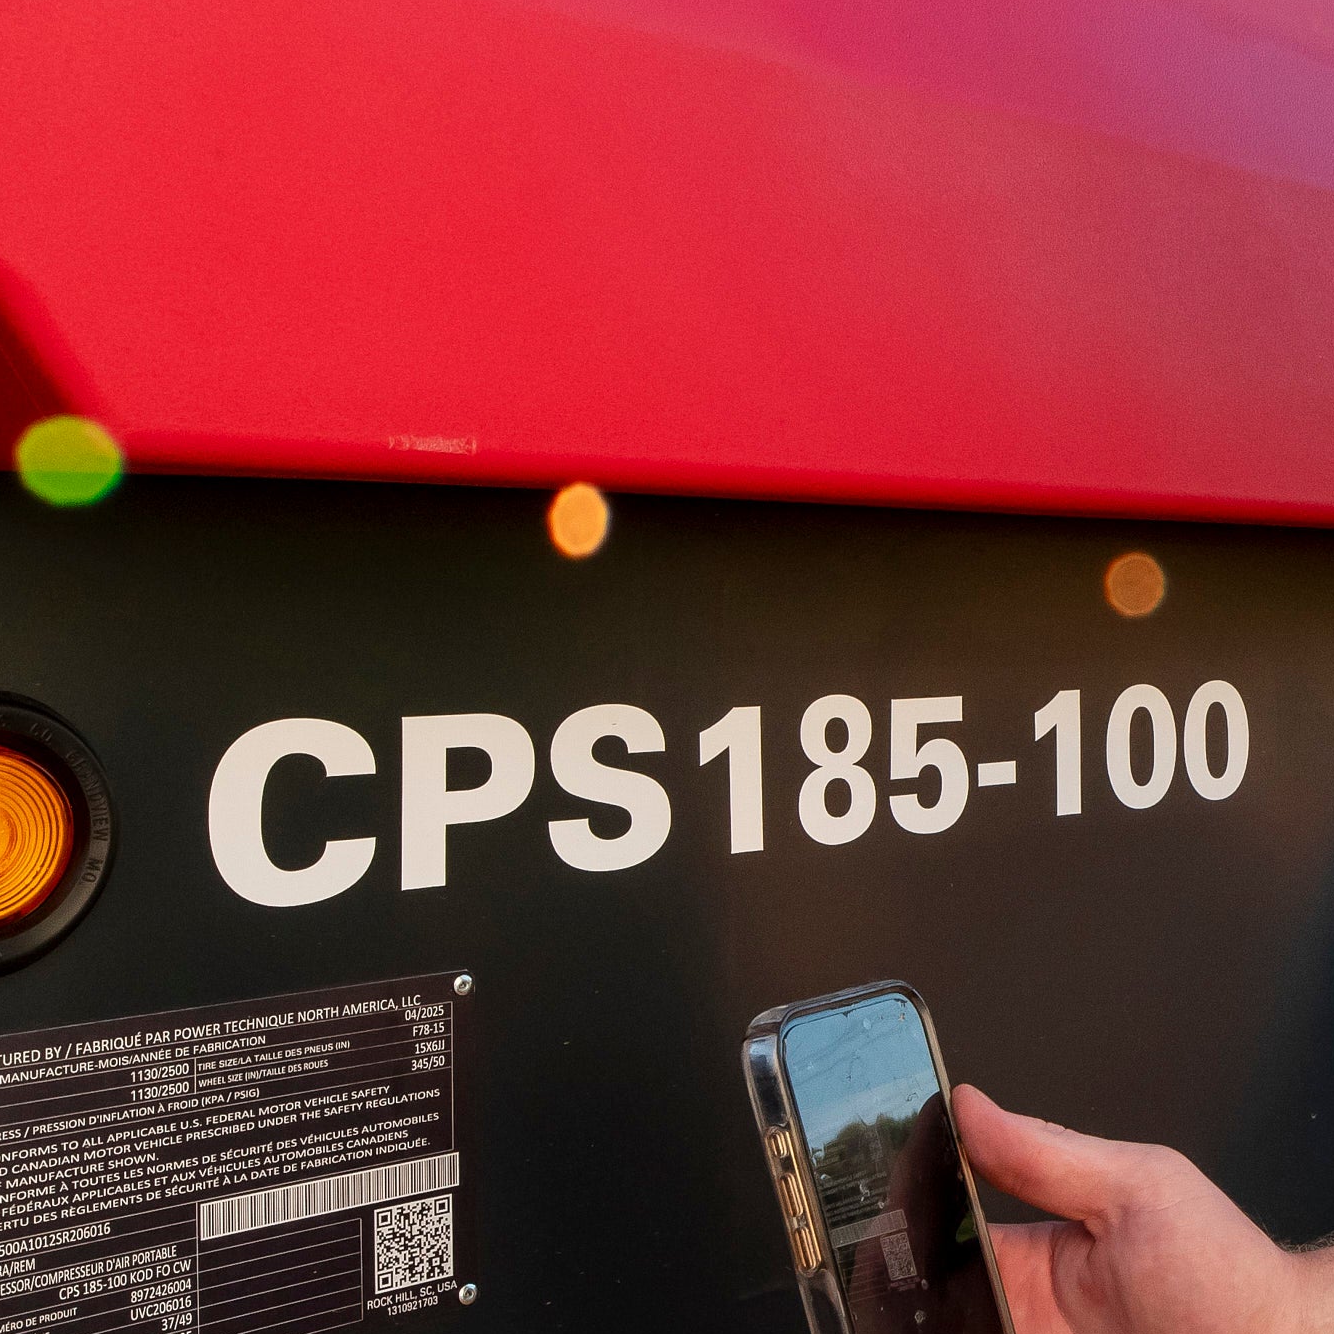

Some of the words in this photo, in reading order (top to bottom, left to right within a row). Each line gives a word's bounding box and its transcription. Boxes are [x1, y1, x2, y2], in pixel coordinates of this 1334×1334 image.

[44, 1045, 62, 1061] BY
[75, 1031, 142, 1056] FABRIQUÉ
[145, 1030, 171, 1046] PAR
[173, 1022, 221, 1042] POWER
[223, 1014, 295, 1034] TECHNIQUE
[297, 1005, 339, 1023] NORTH
[341, 998, 399, 1017] AMERICA,
[401, 994, 422, 1008] LLC
[404, 1004, 445, 1021] 04/2025
[412, 1021, 445, 1037] F78-15
[0, 1047, 172, 1085] MANUFACTURE-MOIS/ANNÉE
[175, 1046, 191, 1058] DE
[193, 1034, 266, 1055] FABRICATION
[196, 1060, 217, 1072] TIRE
[218, 1055, 252, 1069] SIZE/LA
[253, 1050, 283, 1063] TAILLE
[284, 1047, 303, 1058] DES
[304, 1042, 334, 1055] PNEUS
[411, 1054, 446, 1071] 345/50
[130, 1062, 190, 1083] 1130/2500
[130, 1081, 190, 1102] 1130/2500
[11, 1153, 80, 1175] CANADIAN
[83, 1143, 132, 1161] MOTOR
[133, 1134, 183, 1152] VEHICLE
[185, 1121, 255, 1142] PRESCRIBED
[257, 1113, 297, 1129] UNDER
[299, 1109, 321, 1121] THE
[323, 1101, 364, 1117] SAFETY
[365, 1088, 441, 1110] REGULATIONS
[32, 1117, 86, 1136] PRESSION
[88, 1105, 155, 1126] D'INFLATION
[157, 1102, 166, 1114] À
[167, 1098, 199, 1112] FROID
[60, 1140, 79, 1152] TO
[81, 1136, 104, 1149] ALL
[106, 1122, 177, 1144] APPLICABLE
[180, 1118, 203, 1130] U.S.
[205, 1109, 256, 1126] FEDERAL
[258, 1100, 302, 1117] MOTOR
[303, 1092, 349, 1108] VEHICLE
[351, 1085, 390, 1100] SAFETY
[59, 1180, 69, 1193] À
[71, 1172, 121, 1190] TOUTES
[123, 1167, 144, 1180] LES
[146, 1157, 199, 1175] NORMES
[201, 1153, 218, 1165] DE
[220, 1141, 273, 1162] SÉCURITÉ
[276, 1138, 298, 1151] DES
[299, 1127, 359, 1146] VÉHICULES
[361, 1112, 440, 1135] AUTOMOBILES
[1, 1195, 69, 1218] FÉDÉRAUX
[71, 1179, 151, 1204] APPLICABLES
[154, 1175, 169, 1187] ET
[170, 1170, 196, 1184] AUX
[198, 1157, 261, 1178] VÉHICULES
[263, 1141, 345, 1166] AUTOMOBILES
[346, 1129, 409, 1149] CANADIENS
[5, 1161, 105, 1190] MANUFACTURE
[107, 1152, 159, 1170] SHOWN.
[33, 1211, 58, 1225] DES
[60, 1193, 143, 1219] RÈGLEMENTS
[146, 1189, 162, 1202] DE
[164, 1176, 220, 1198] SÉCURITÉ
[222, 1174, 232, 1186] À
[233, 1173, 249, 1184] LA
[250, 1166, 280, 1180] DATE
[282, 1162, 298, 1174] DE
[300, 1148, 373, 1170] FABRICATION
[375, 1137, 431, 1156] INDIQUÉE.
[106, 1255, 131, 1273] D'AIR
[131, 1244, 177, 1267] PORTABLE
[58, 1284, 80, 1301] CPS
[82, 1273, 128, 1295] 185-100
[129, 1268, 154, 1285] KOD
[156, 1263, 171, 1279] FO
[172, 1258, 192, 1274] CW
[130, 1277, 192, 1304] 8972426004
[130, 1295, 192, 1322] UVC206016
[366, 1294, 393, 1311] ROCK
[395, 1290, 418, 1304] HILL,
[419, 1285, 435, 1298] SC,
[437, 1279, 458, 1293] USA
[387, 1295, 439, 1316] 1310921703
[25, 1316, 38, 1328] DE
[39, 1306, 78, 1324] PRODUIT
[161, 1312, 193, 1332] 37/49
